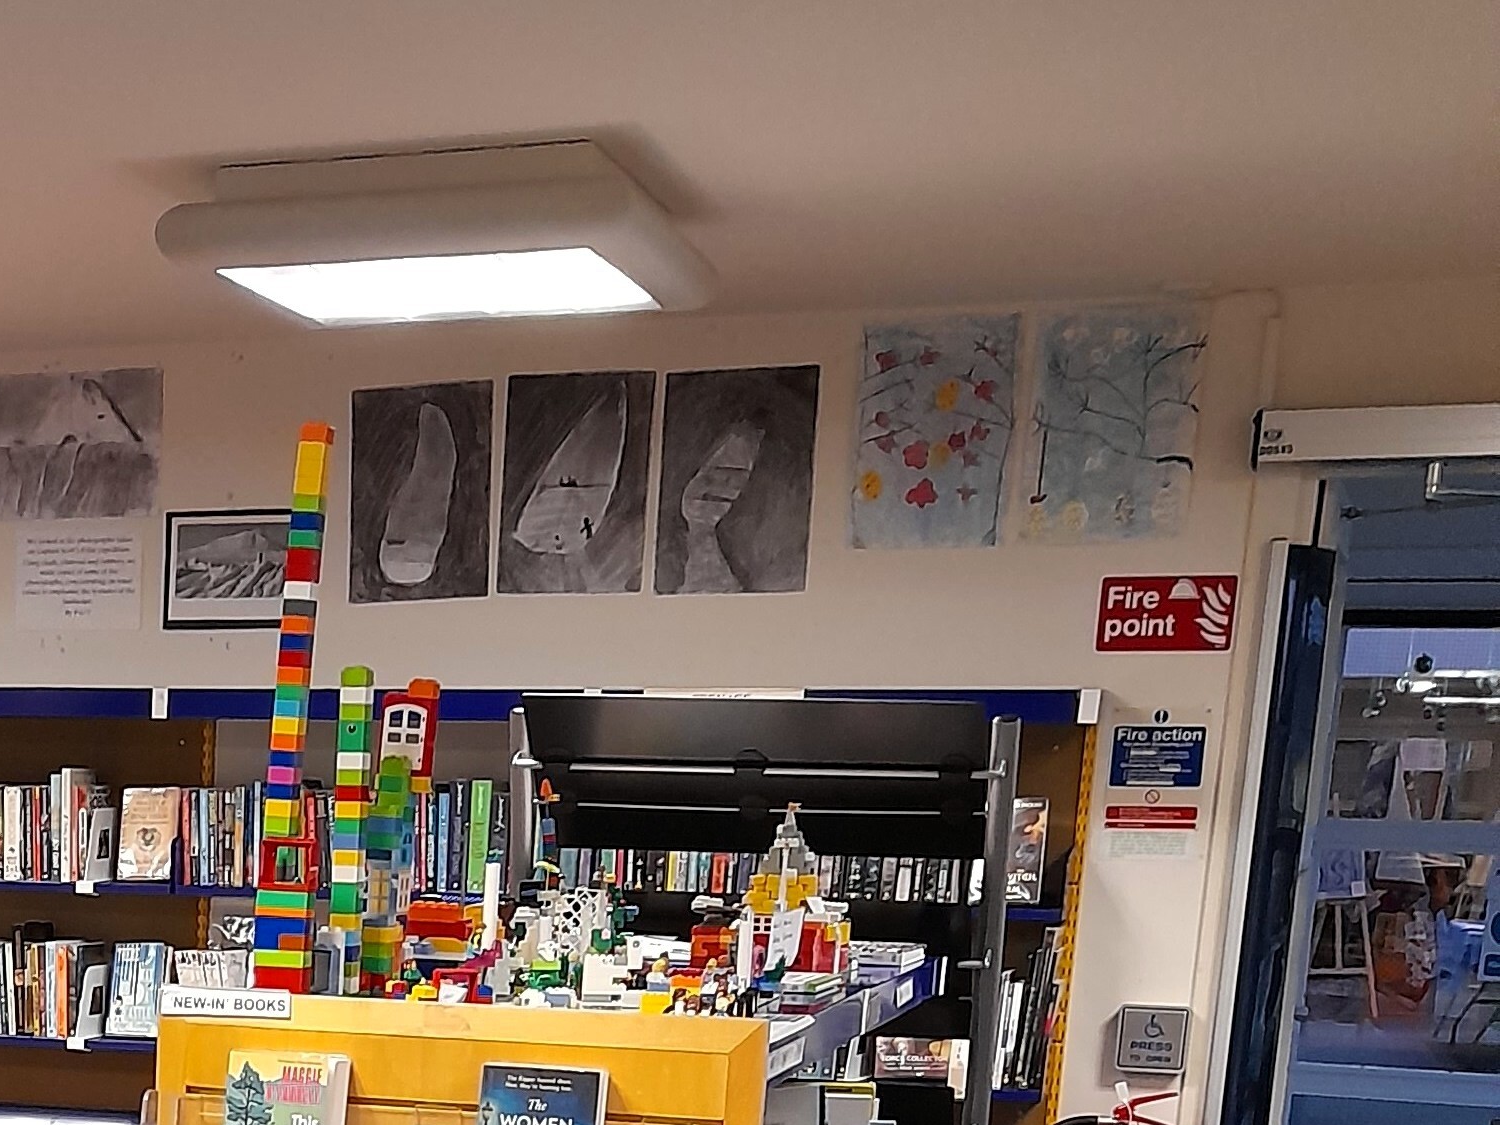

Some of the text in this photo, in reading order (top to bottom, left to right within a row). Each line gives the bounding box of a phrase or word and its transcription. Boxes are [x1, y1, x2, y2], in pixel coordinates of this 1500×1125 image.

[1107, 586, 1160, 609] Fire
[1104, 613, 1175, 642] point
[1117, 728, 1203, 741] Fire action
[233, 998, 286, 1011] BOOKS
[528, 1099, 548, 1112] The
